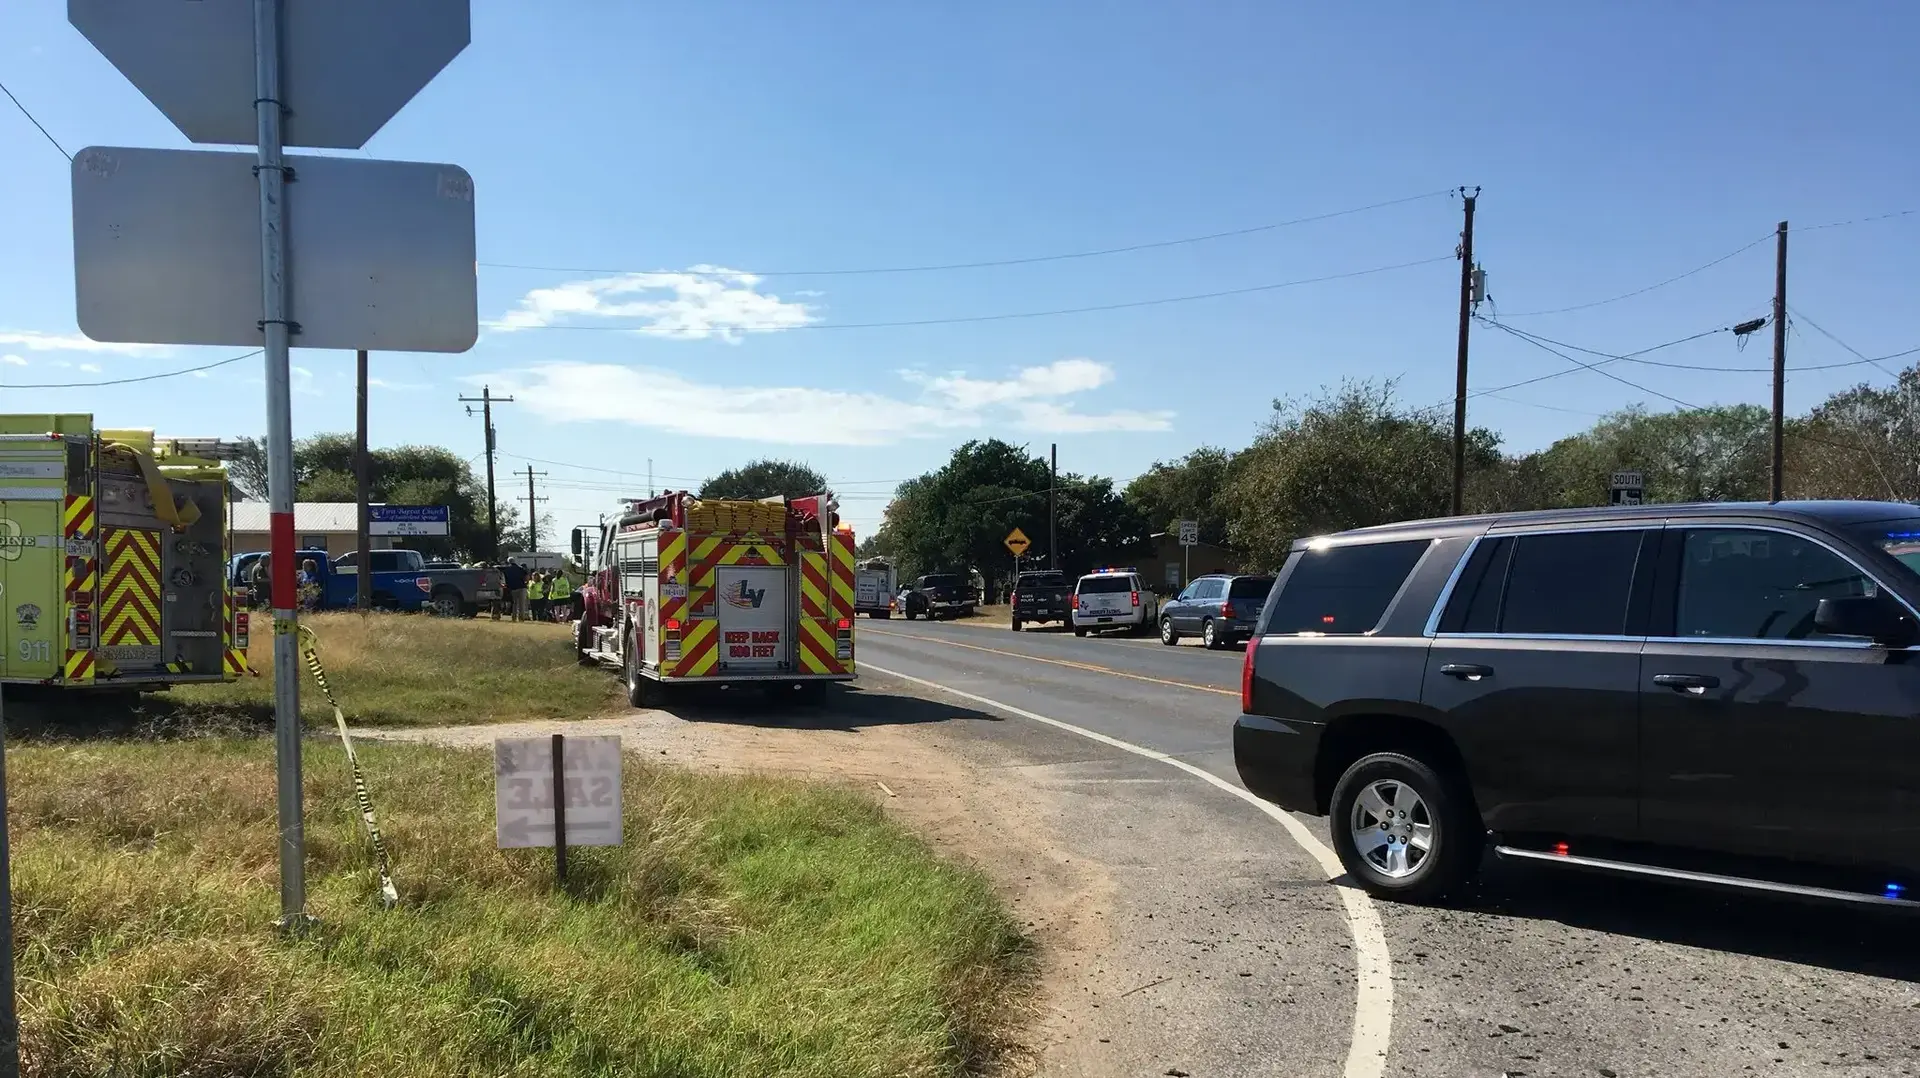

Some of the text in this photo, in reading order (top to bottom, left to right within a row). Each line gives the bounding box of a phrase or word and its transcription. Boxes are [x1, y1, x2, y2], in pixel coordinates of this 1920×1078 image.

[1614, 474, 1641, 485] SOUTH
[421, 506, 444, 515] Church
[1181, 533, 1197, 543] 45
[740, 579, 766, 608] LV
[724, 631, 780, 644] KEEP BACK
[19, 638, 51, 662] 911
[752, 645, 776, 658] FEET
